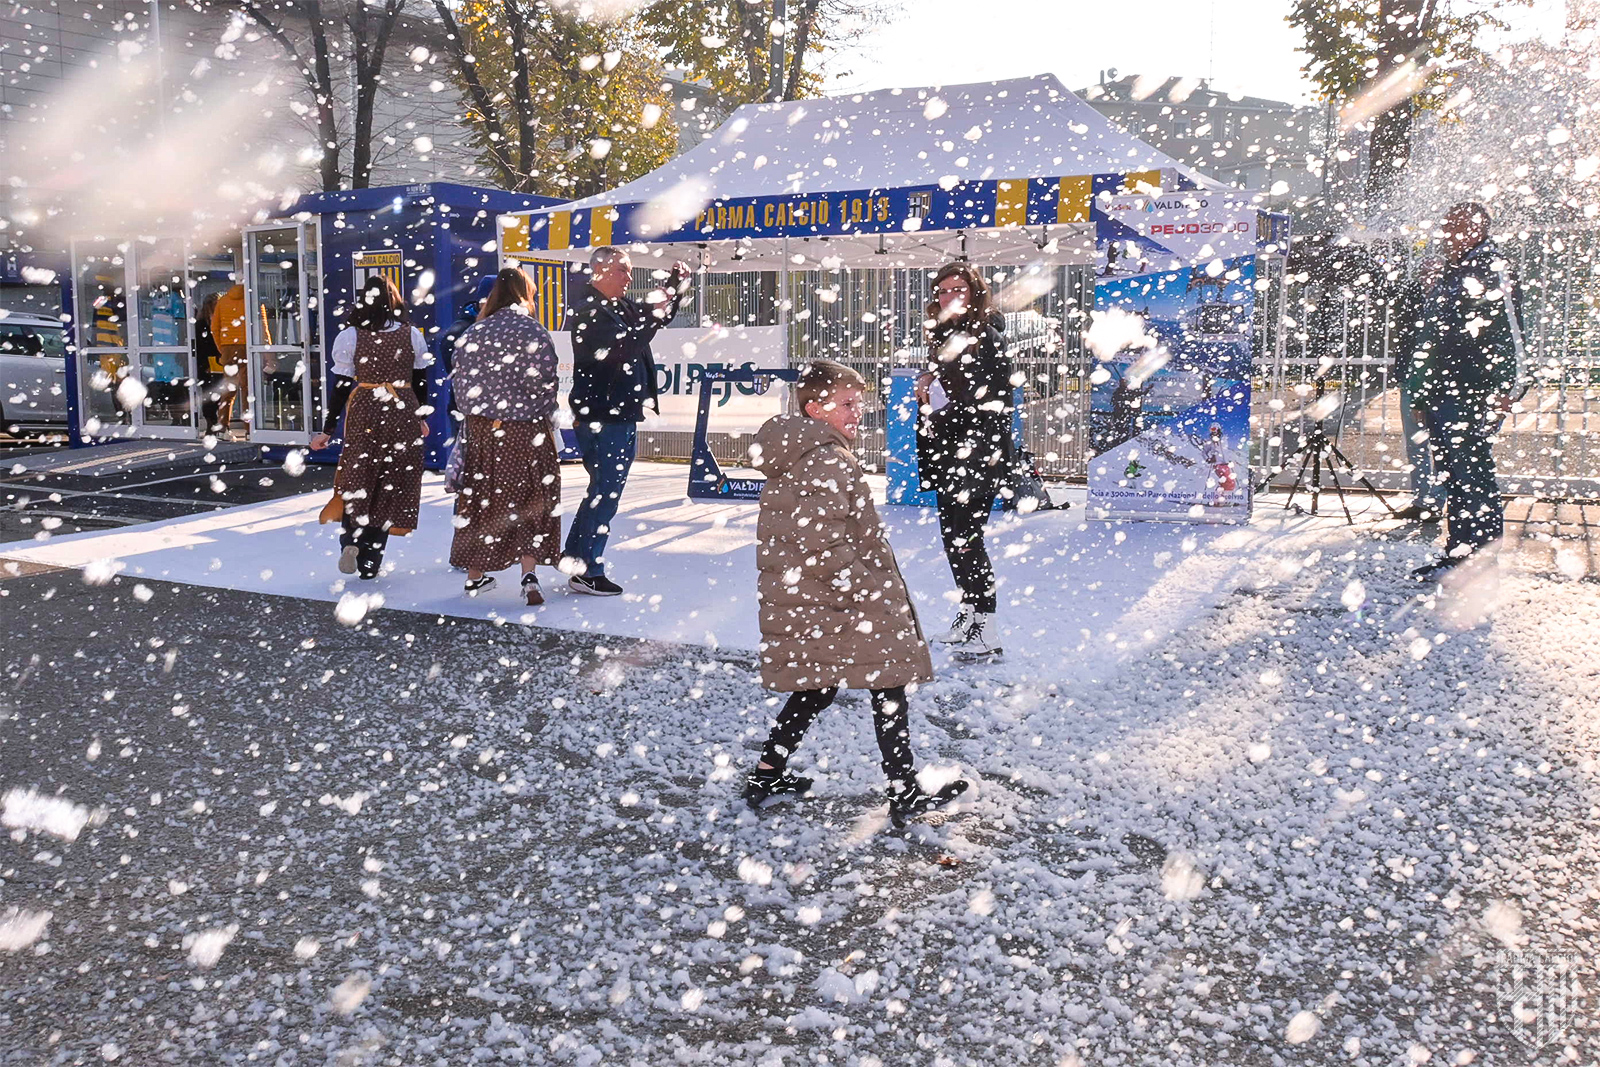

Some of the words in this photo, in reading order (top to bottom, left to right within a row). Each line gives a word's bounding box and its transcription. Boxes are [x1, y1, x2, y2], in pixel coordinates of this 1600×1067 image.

[694, 205, 755, 231] PARMA
[764, 200, 829, 227] CALCIO
[840, 196, 889, 223] 1913
[1154, 201, 1173, 210] VAL
